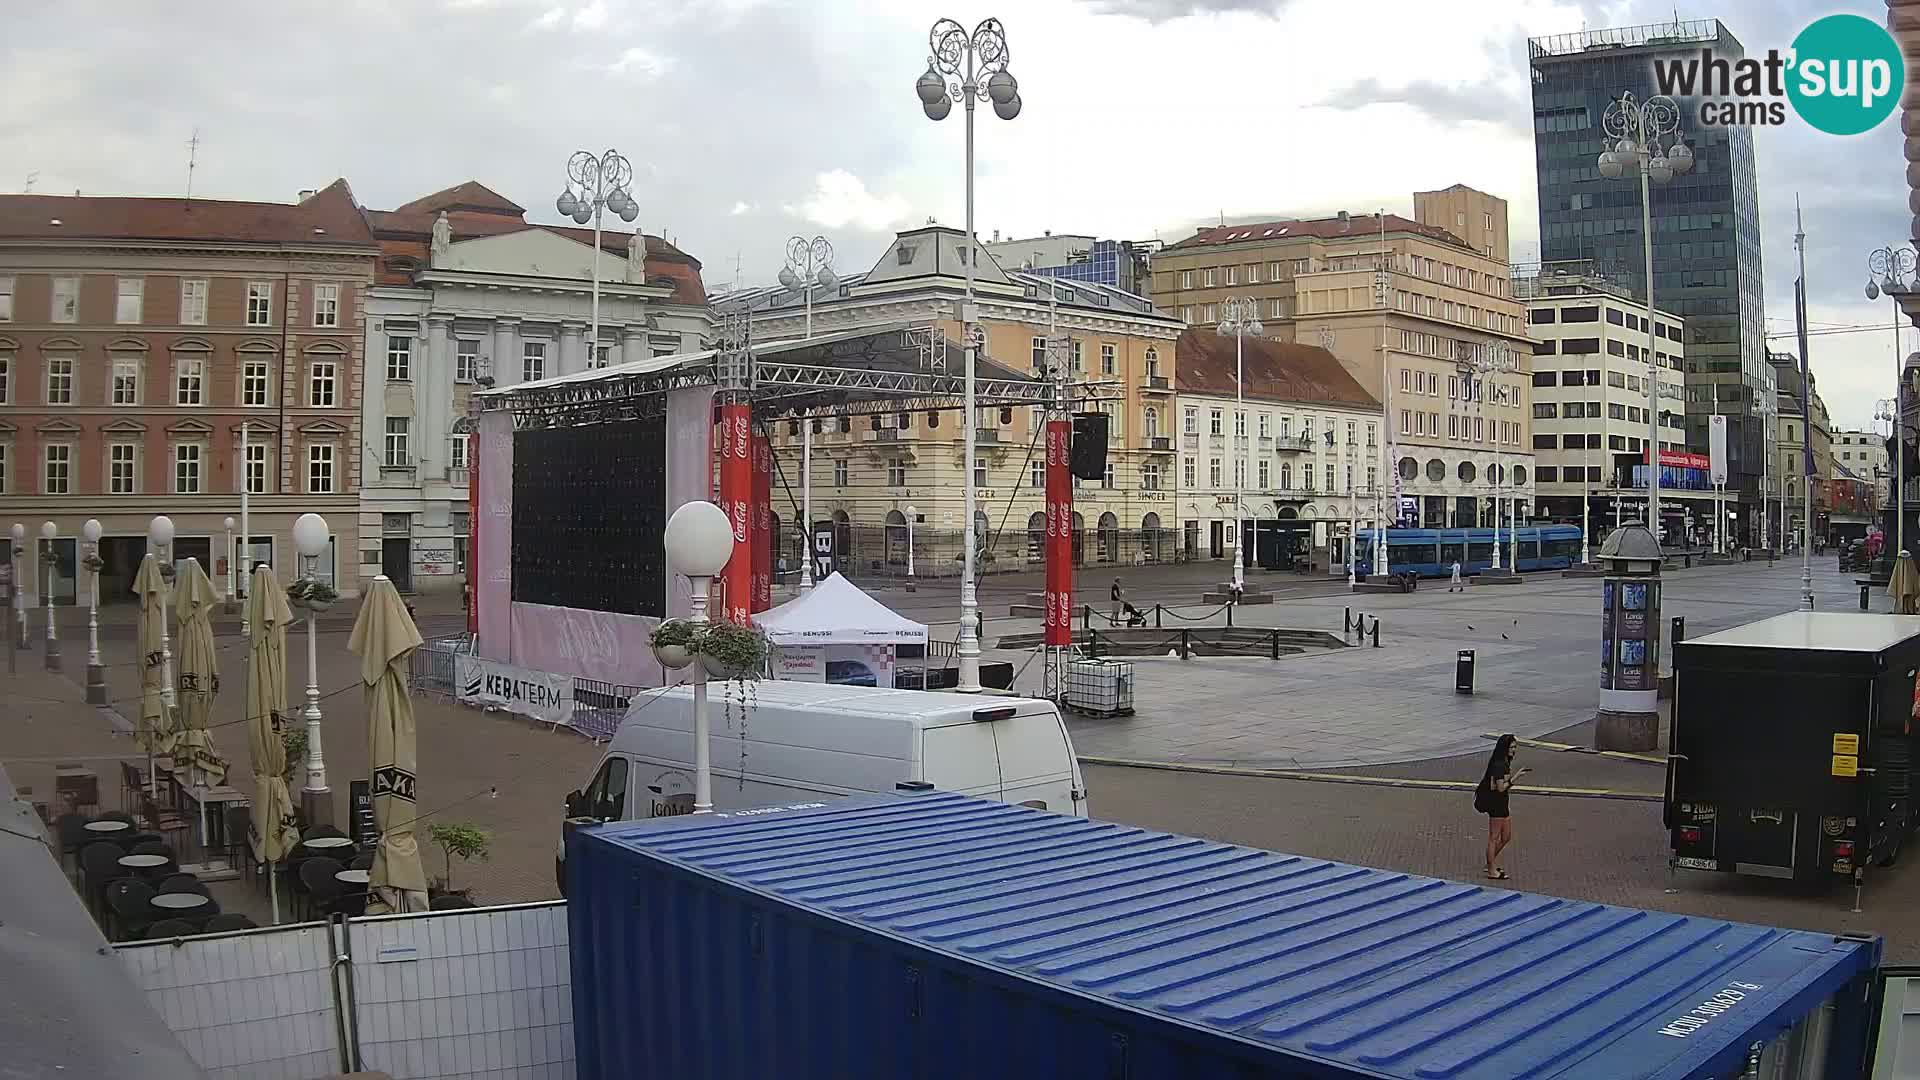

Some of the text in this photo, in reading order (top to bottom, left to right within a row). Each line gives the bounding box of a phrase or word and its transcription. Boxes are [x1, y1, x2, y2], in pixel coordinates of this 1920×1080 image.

[1138, 492, 1166, 501] SINGER
[1657, 1014, 1709, 1038] MCDU
[1690, 988, 1747, 1017] 300629
